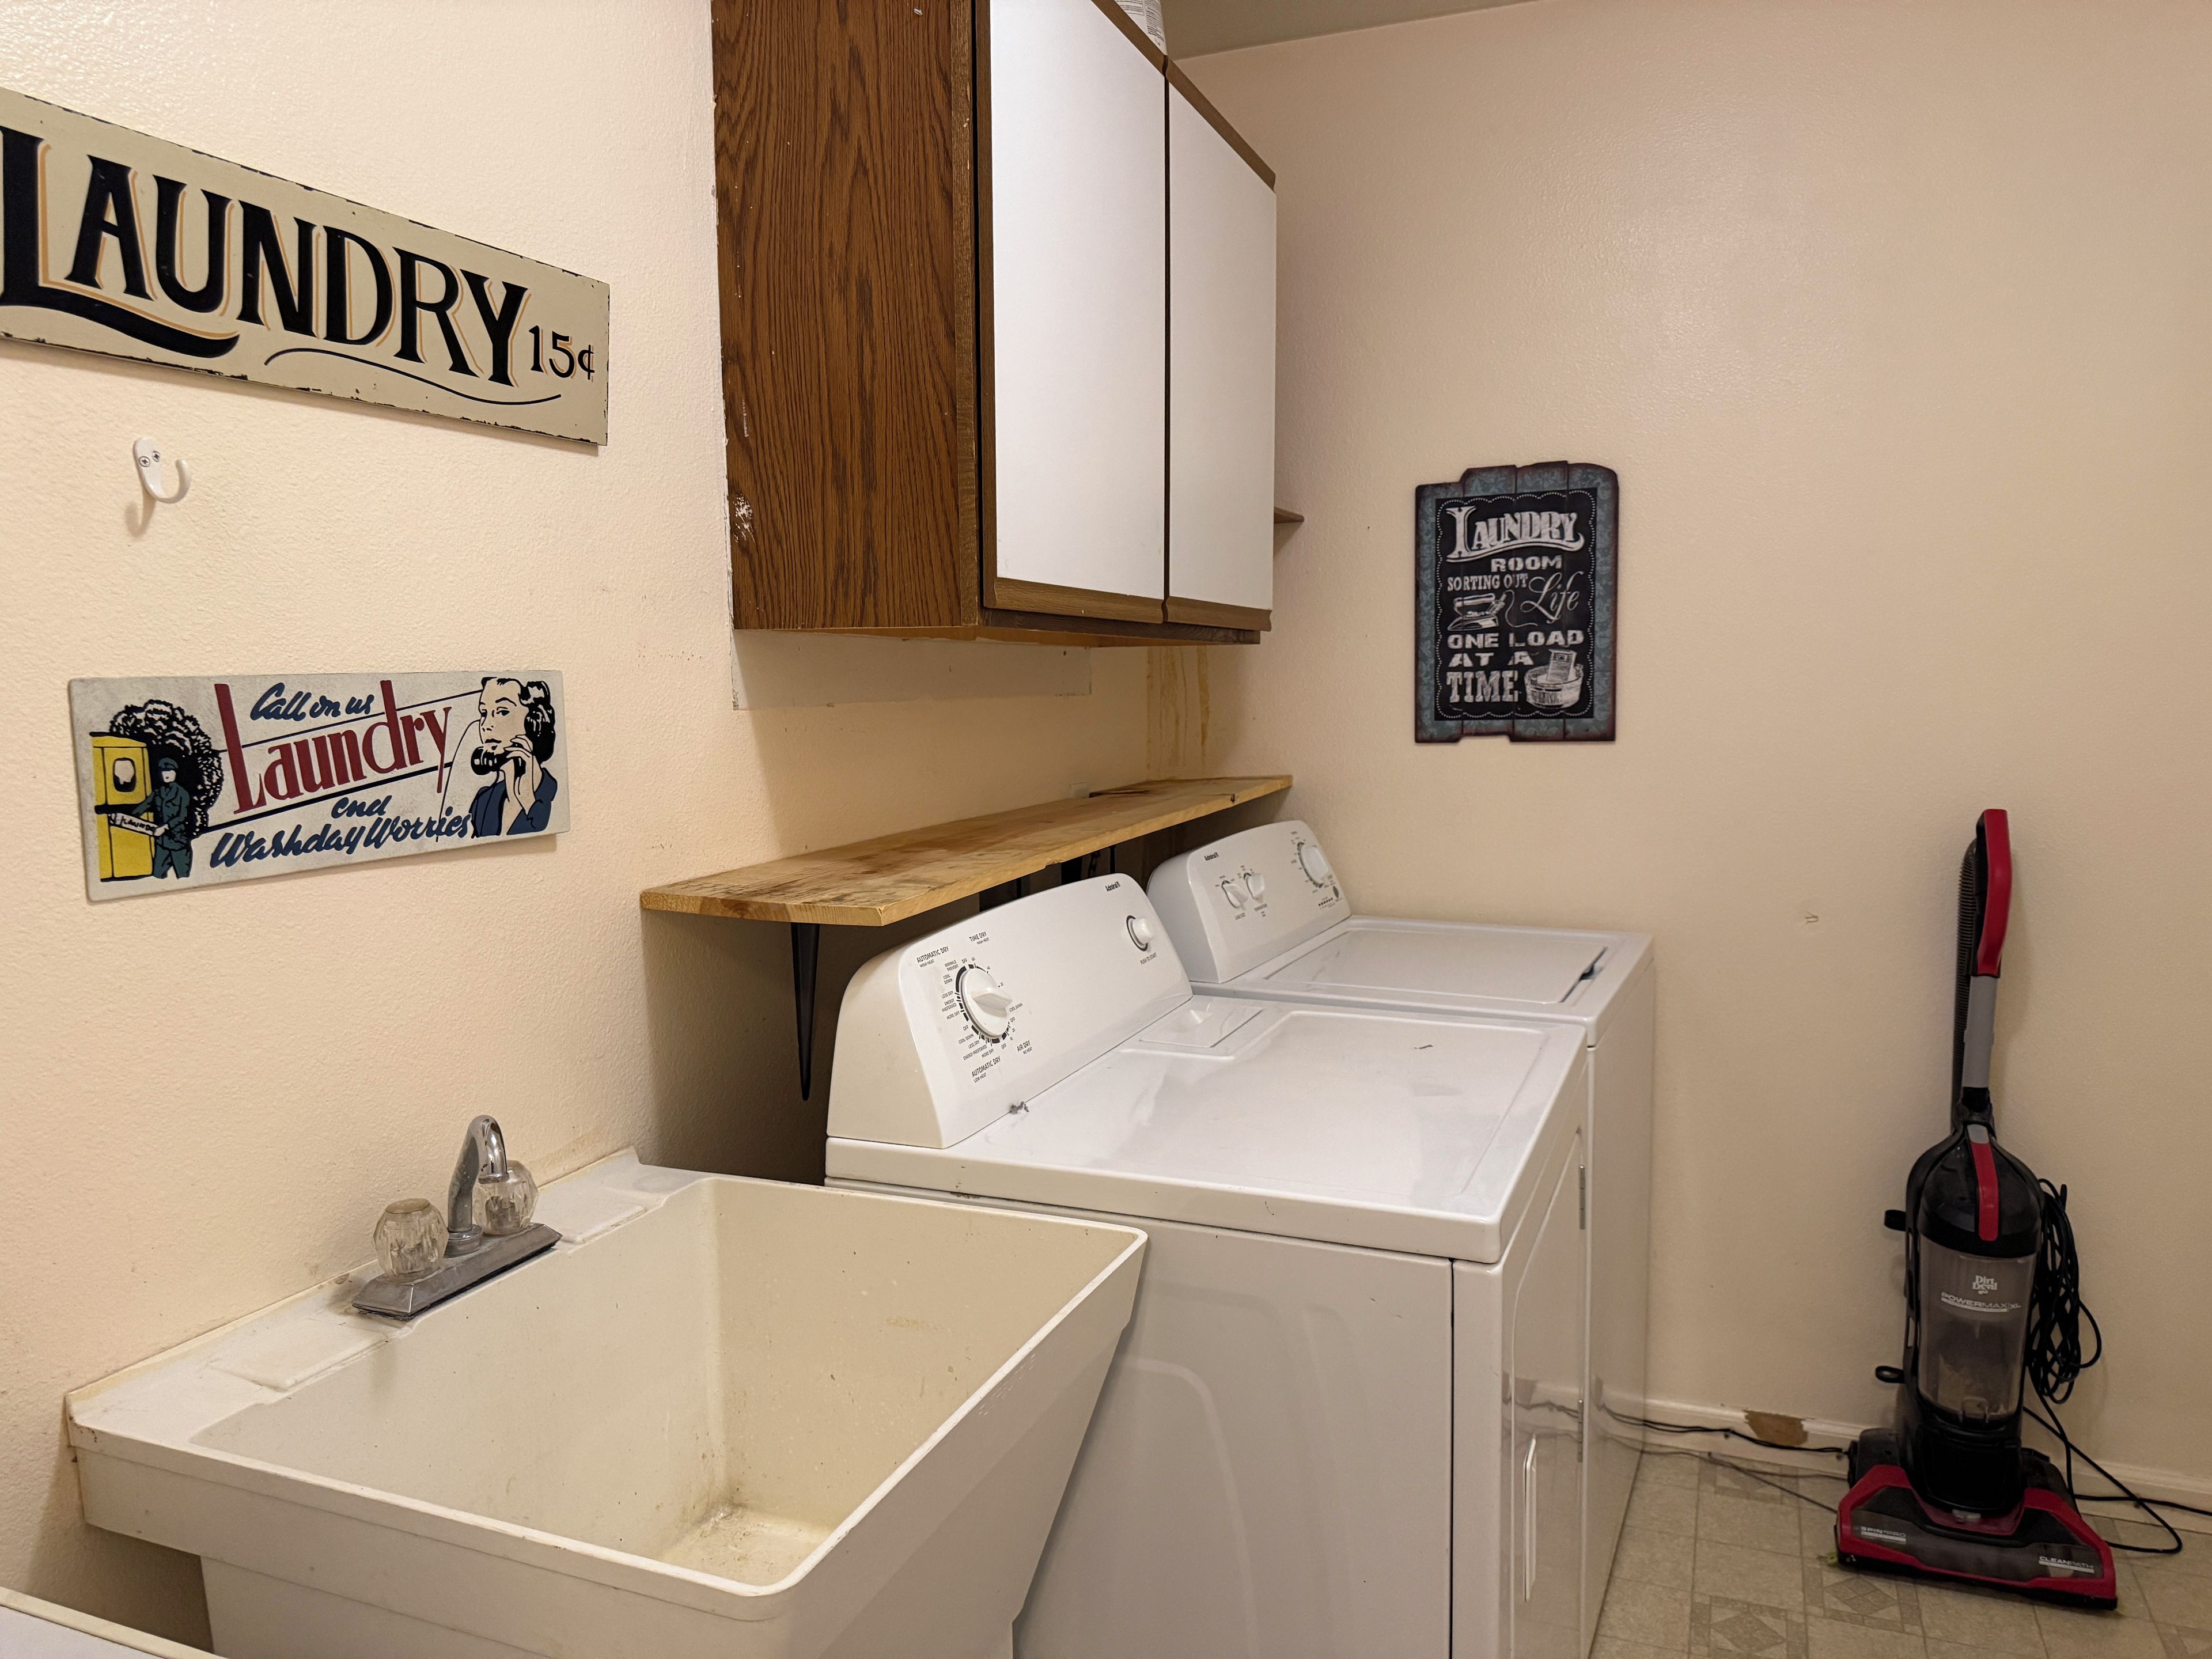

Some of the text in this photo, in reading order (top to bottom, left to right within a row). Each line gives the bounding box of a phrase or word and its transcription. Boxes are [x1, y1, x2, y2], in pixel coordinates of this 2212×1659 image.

[0, 126, 595, 387] LAUNDRY 15¢
[1445, 505, 1585, 563] LAUNDRY
[1491, 555, 1562, 573] ROOM
[1447, 573, 1529, 592] SORTING OUT
[1520, 570, 1584, 624] Life
[1447, 629, 1584, 649] ONE LOAD
[1448, 650, 1534, 668] AT A
[1446, 670, 1519, 703] TIME
[249, 682, 375, 722] Call on us
[214, 680, 452, 815] Laundry
[210, 806, 472, 869] Washday Worries
[969, 934, 980, 942] TIME
[916, 946, 949, 963] AUTOMATIC DRY
[1022, 1040, 1031, 1049] DRY
[972, 1056, 1001, 1078] AUTOMATIC DRY
